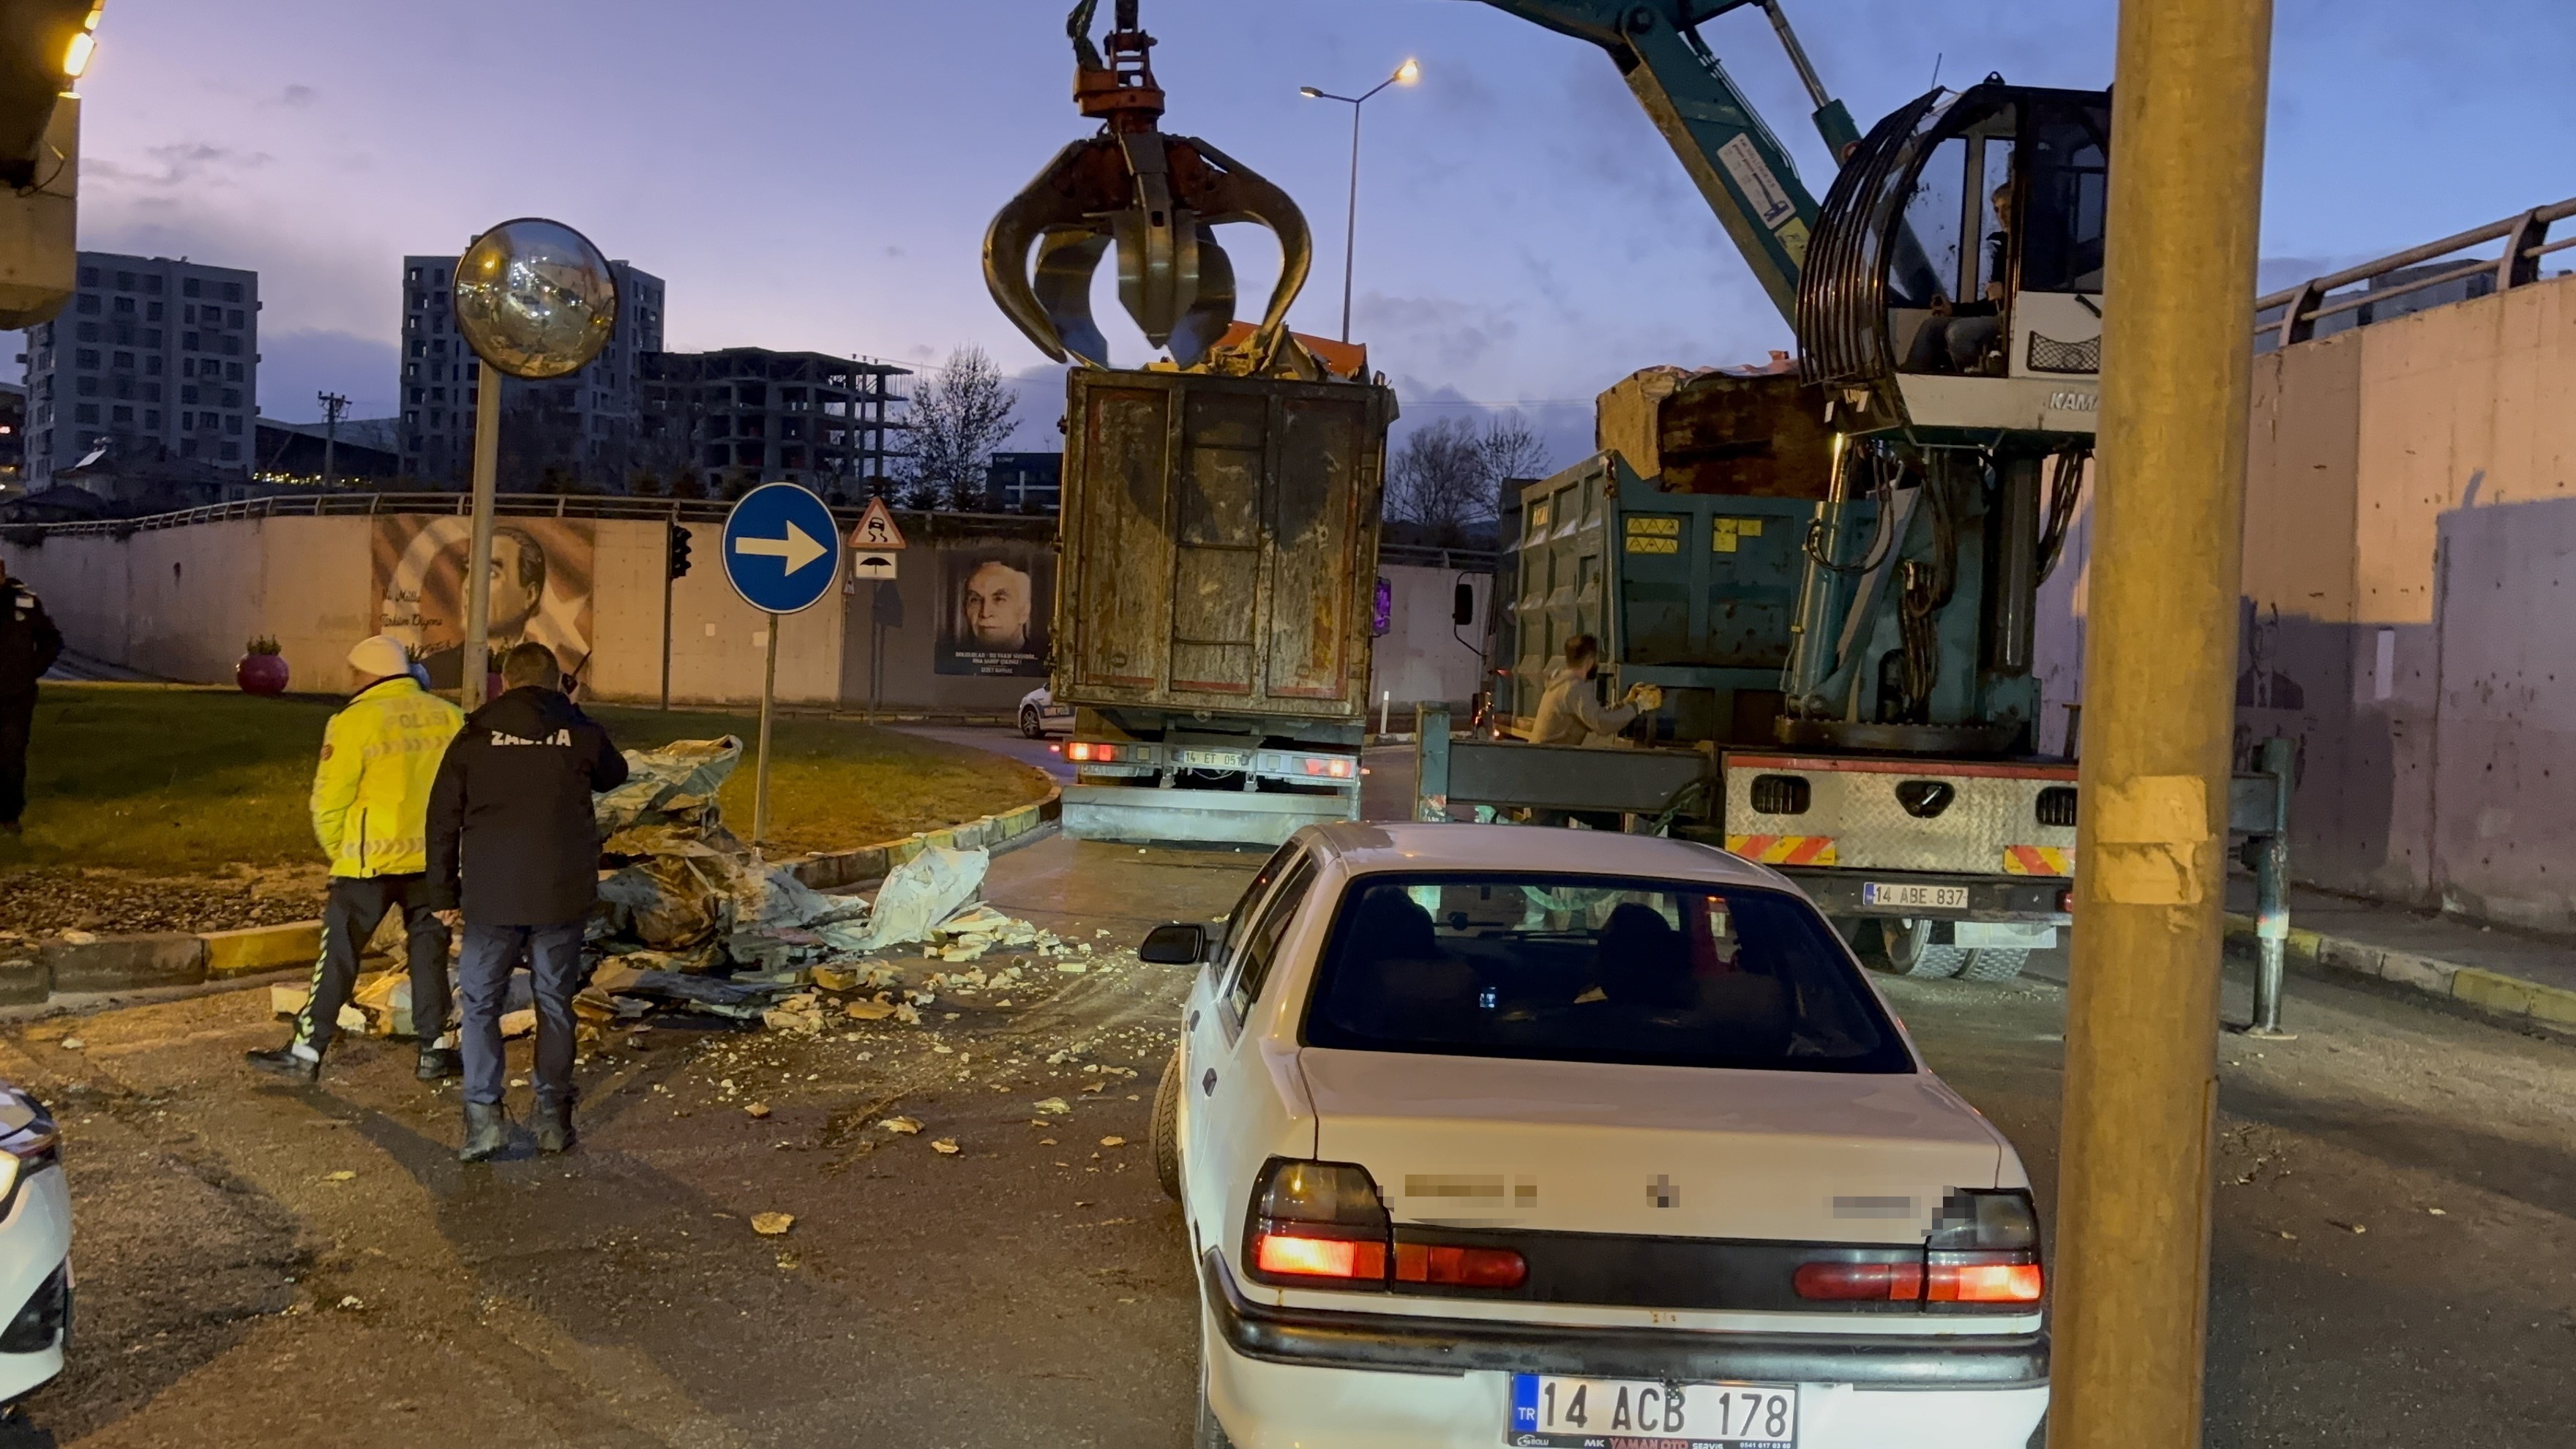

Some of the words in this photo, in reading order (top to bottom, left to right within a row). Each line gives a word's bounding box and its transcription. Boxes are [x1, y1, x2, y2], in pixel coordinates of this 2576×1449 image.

[1186, 752, 1196, 763] 14
[1205, 753, 1216, 764] ET
[1876, 886, 1891, 902] 14
[1900, 887, 1928, 905] ABE
[1936, 888, 1964, 905] 837
[1518, 1407, 1536, 1420] TR
[1544, 1382, 1588, 1428] 14
[1611, 1386, 1686, 1433] ACB
[1719, 1392, 1787, 1438] 178
[1584, 1439, 1605, 1448] MK
[1610, 1437, 1658, 1449] YAMAN
[1660, 1439, 1689, 1449] OTO
